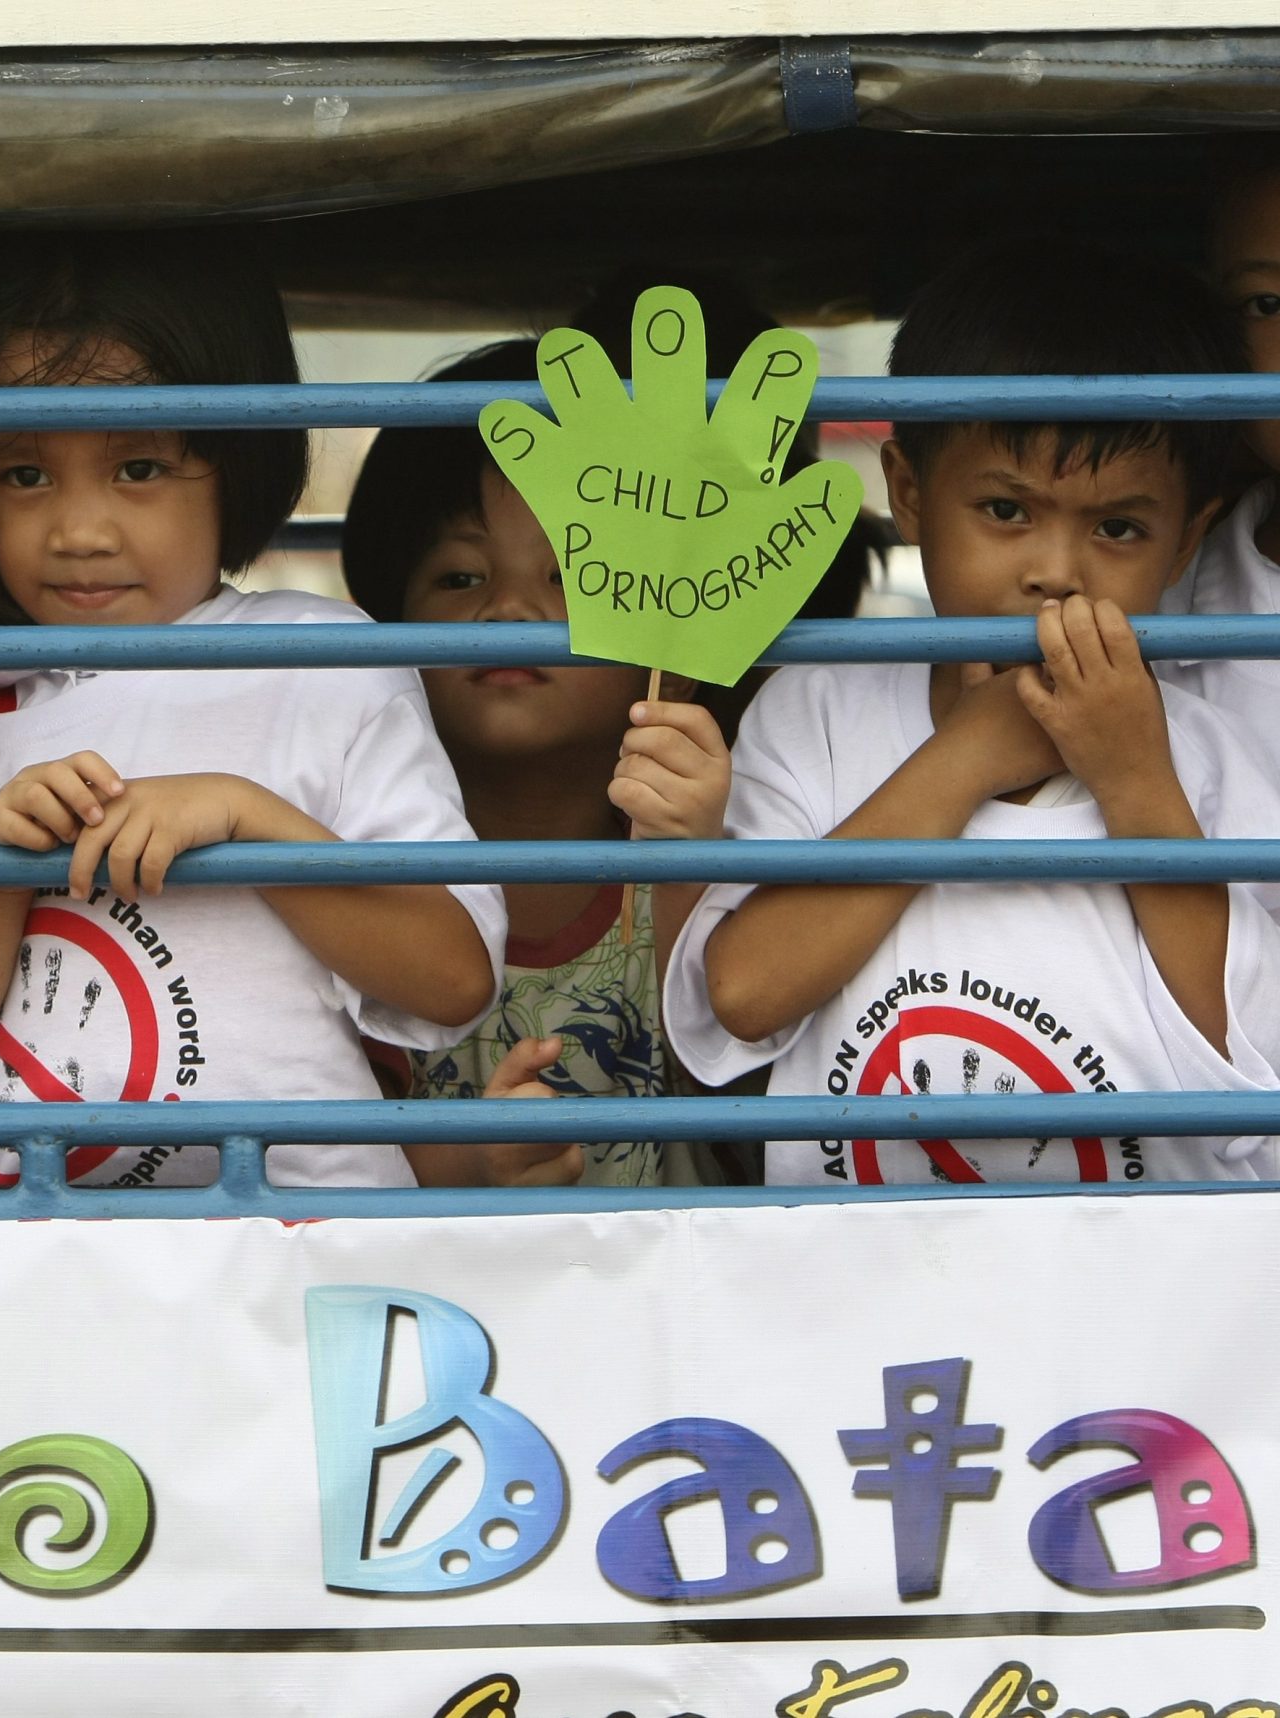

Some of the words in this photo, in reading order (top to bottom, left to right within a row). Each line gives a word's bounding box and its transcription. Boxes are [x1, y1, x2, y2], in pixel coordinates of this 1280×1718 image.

[564, 479, 837, 618] PORNOGRAPHY
[576, 464, 729, 520] CHILD
[109, 897, 174, 970] than
[167, 975, 206, 1087] words
[820, 1038, 860, 1181] ACON
[856, 968, 949, 1039] speaks
[959, 970, 1073, 1045] louder
[1072, 1044, 1118, 1093] tha
[304, 1282, 1260, 1606] Bata
